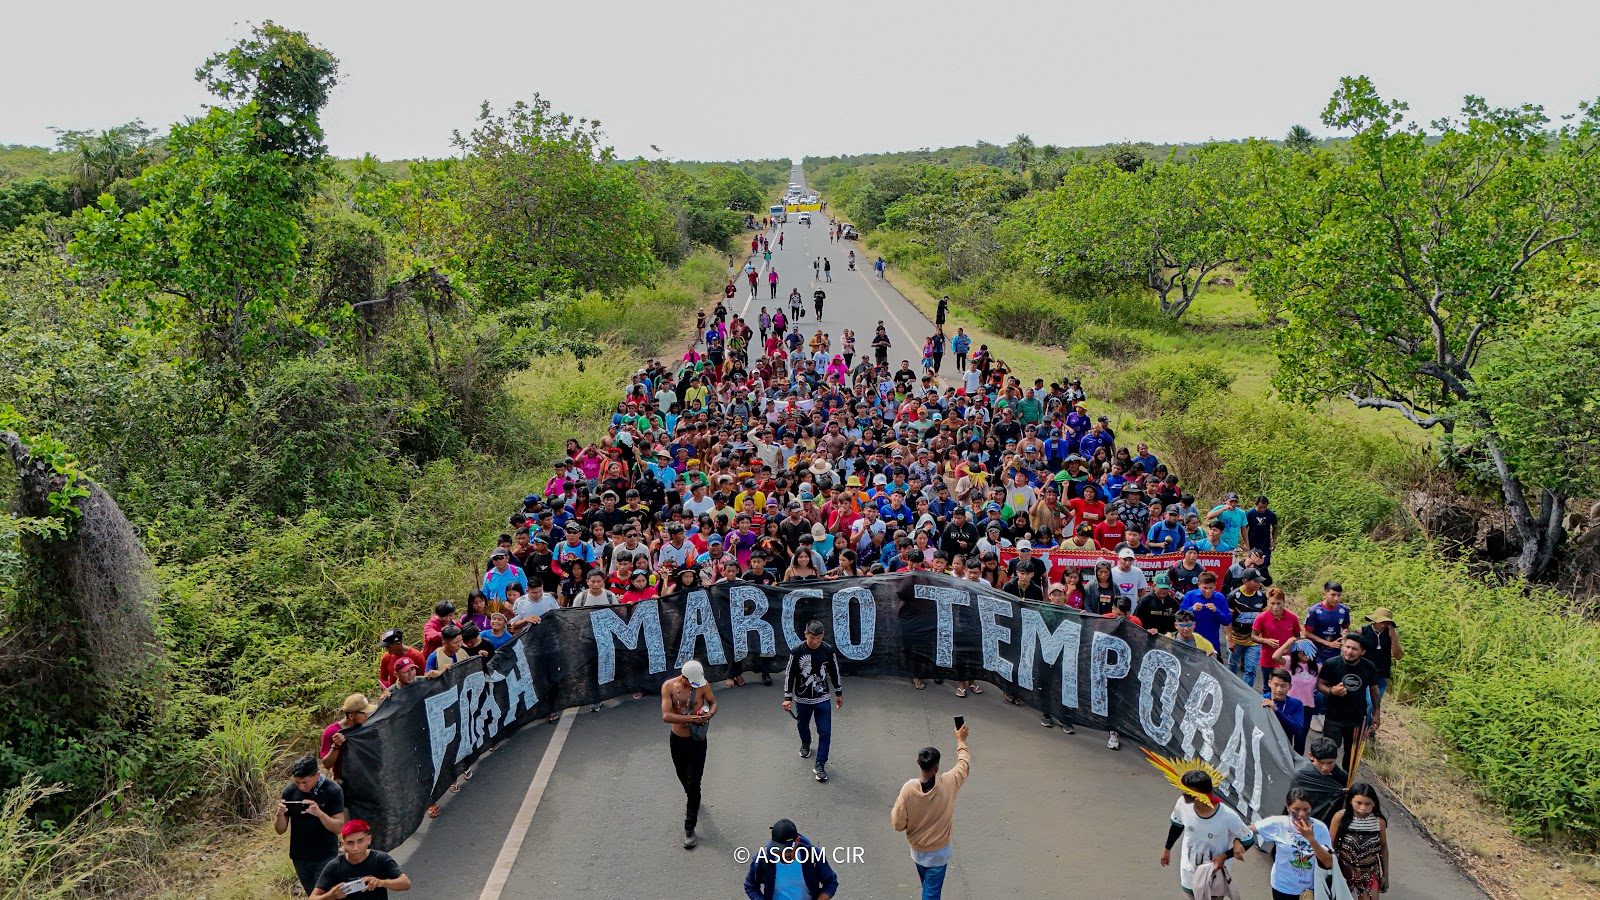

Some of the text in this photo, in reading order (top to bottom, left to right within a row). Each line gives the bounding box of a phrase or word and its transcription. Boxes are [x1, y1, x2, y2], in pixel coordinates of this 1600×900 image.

[950, 531, 970, 539] BOSS
[1057, 558, 1115, 567] MOVIMEO
[590, 586, 877, 685] MARCO
